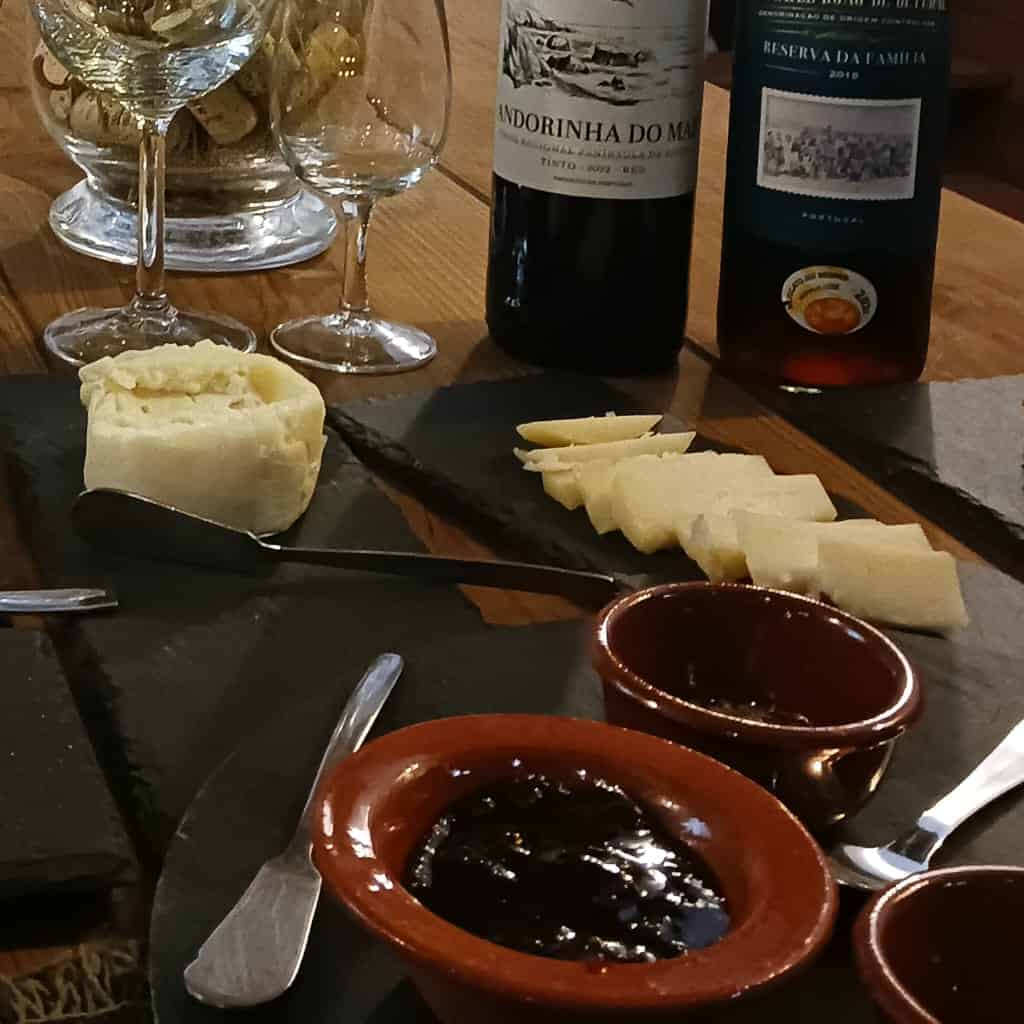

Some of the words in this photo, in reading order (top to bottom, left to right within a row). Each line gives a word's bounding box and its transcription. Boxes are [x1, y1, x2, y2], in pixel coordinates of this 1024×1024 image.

[763, 39, 832, 63] RESERVA
[835, 49, 861, 65] DA
[628, 122, 662, 144] DO
